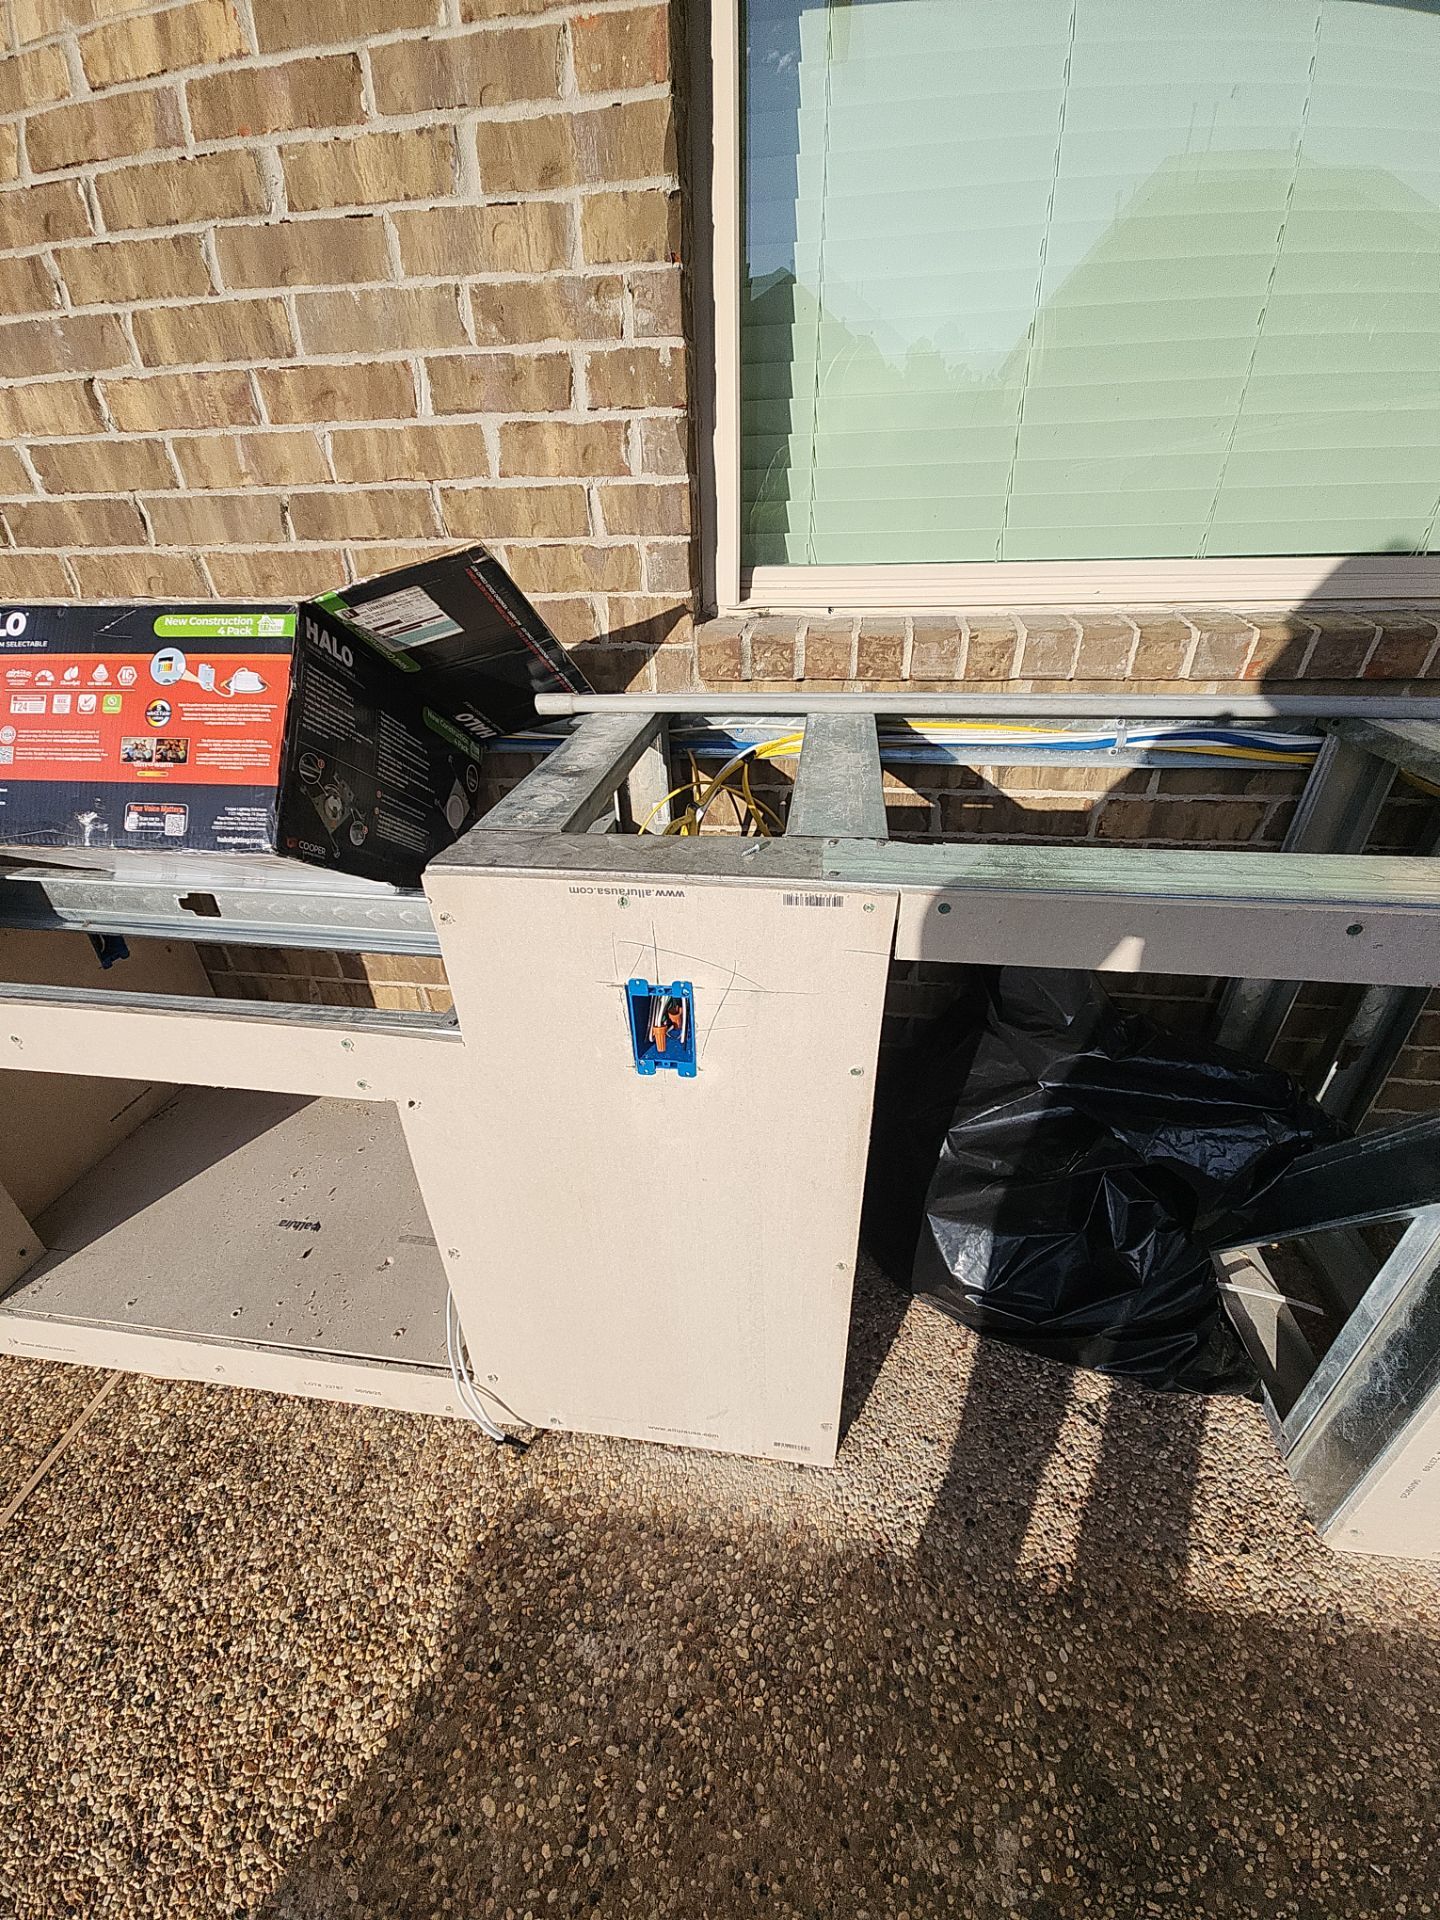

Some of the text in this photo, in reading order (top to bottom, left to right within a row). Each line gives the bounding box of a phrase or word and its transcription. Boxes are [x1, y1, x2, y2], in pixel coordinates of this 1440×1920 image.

[164, 616, 254, 626] New Construction
[217, 627, 252, 636] 4 Pack
[5, 640, 49, 648] SELECTABLE
[305, 616, 354, 668] HALO
[121, 670, 133, 681] IC
[13, 702, 28, 712] T24
[455, 713, 498, 739] HALO
[299, 840, 326, 856] COOPER
[568, 886, 686, 898] www.allurausa.com
